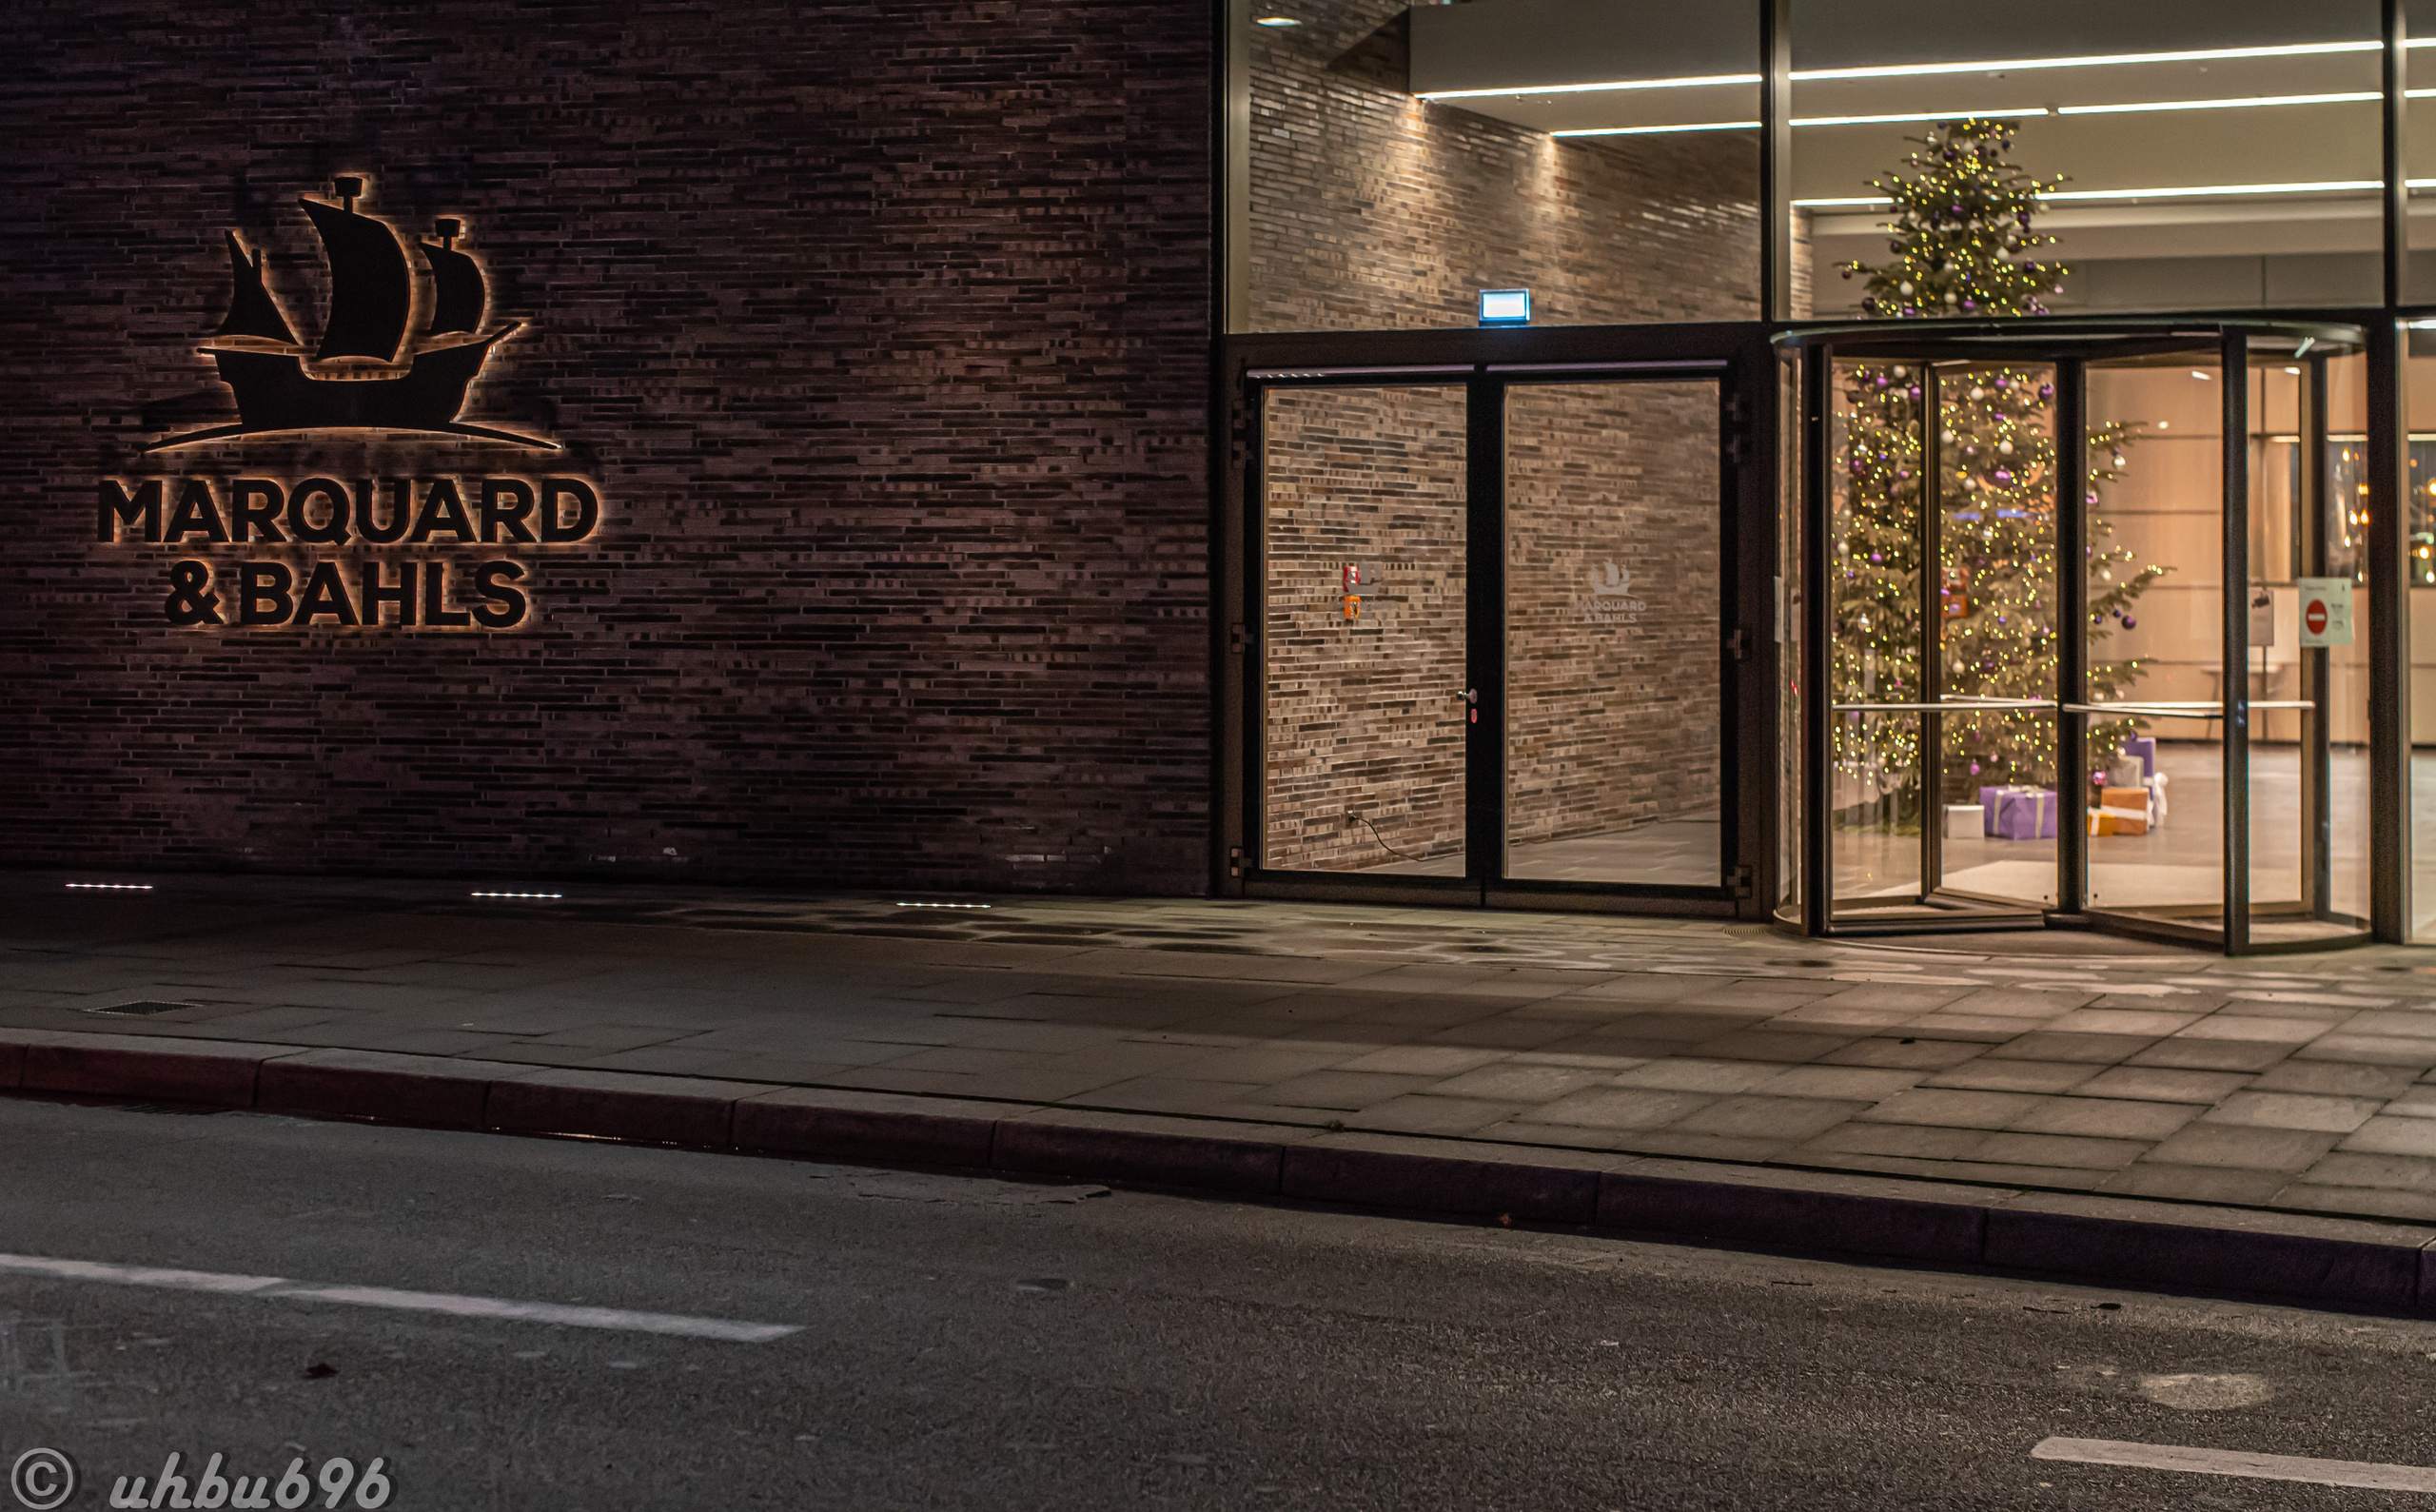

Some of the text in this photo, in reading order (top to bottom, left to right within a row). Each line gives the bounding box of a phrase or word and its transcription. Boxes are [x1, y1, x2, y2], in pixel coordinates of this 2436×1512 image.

[97, 478, 599, 546] MARQUARD
[164, 560, 527, 628] & BAHLS
